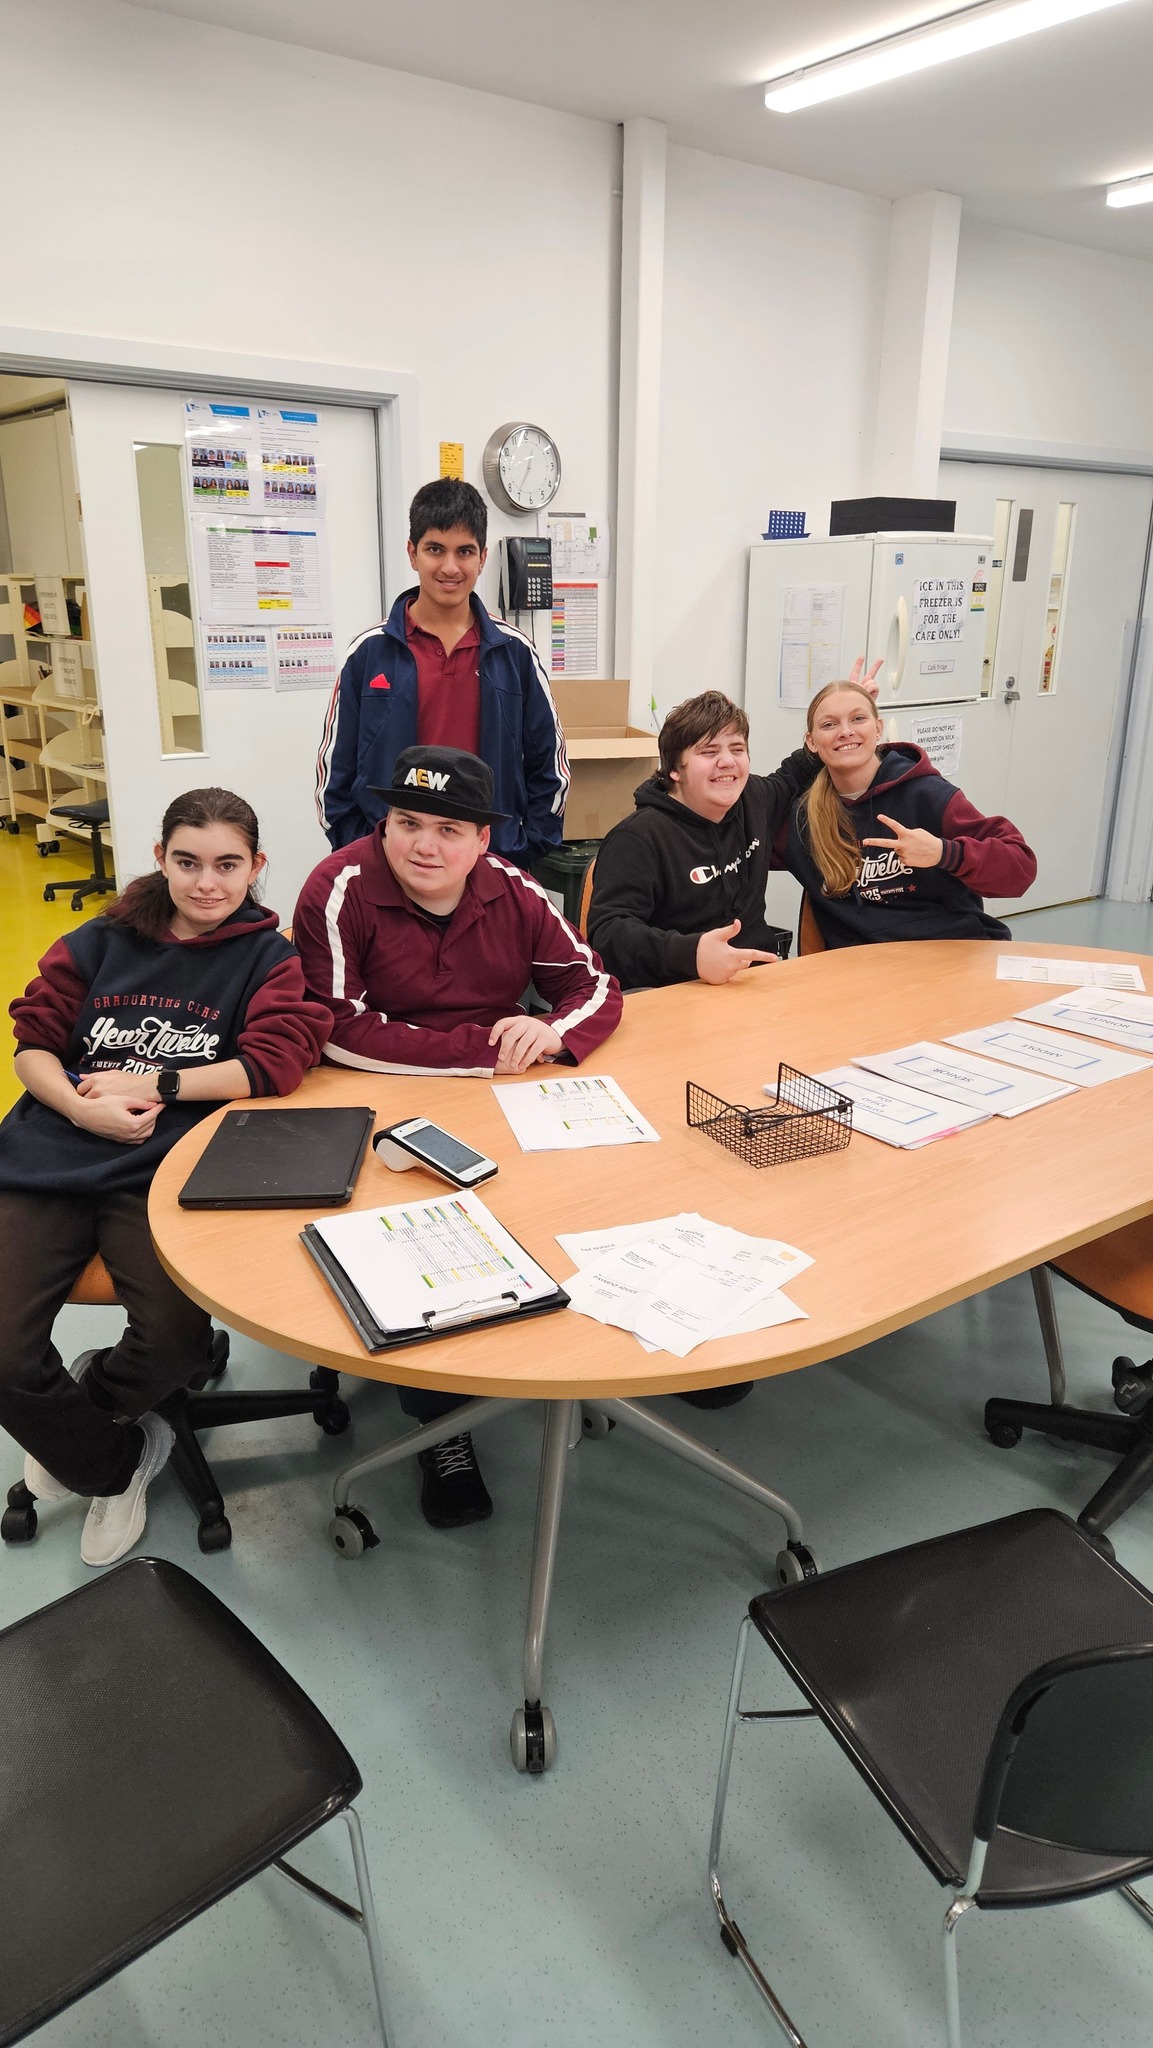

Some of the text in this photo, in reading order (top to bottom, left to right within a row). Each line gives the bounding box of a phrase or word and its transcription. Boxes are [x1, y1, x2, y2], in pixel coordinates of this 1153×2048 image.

[512, 436, 517, 445] 11
[504, 447, 509, 457] 10
[502, 466, 506, 475] 9
[551, 462, 554, 471] 3
[508, 483, 512, 492] 8
[517, 492, 521, 502] 7
[530, 495, 533, 504] 6
[541, 491, 545, 500] 5
[919, 582, 933, 591] ICE
[936, 581, 944, 591] IN
[947, 580, 964, 591] THIS
[919, 597, 963, 608] FREEZER IS
[923, 614, 957, 624] FOR THE
[915, 630, 960, 641] CAFE ONLY!
[404, 767, 450, 791] AEW
[94, 994, 181, 1009] GRADUATING
[1088, 1016, 1130, 1028] JUNIOR
[85, 1017, 220, 1060] Year Twelve
[1019, 1044, 1063, 1058] MIDDLE
[91, 1060, 122, 1068] TWENTY
[933, 1068, 974, 1083] SENIOR
[593, 1275, 618, 1288] PAYMENT
[619, 1285, 639, 1295] ADVICE
